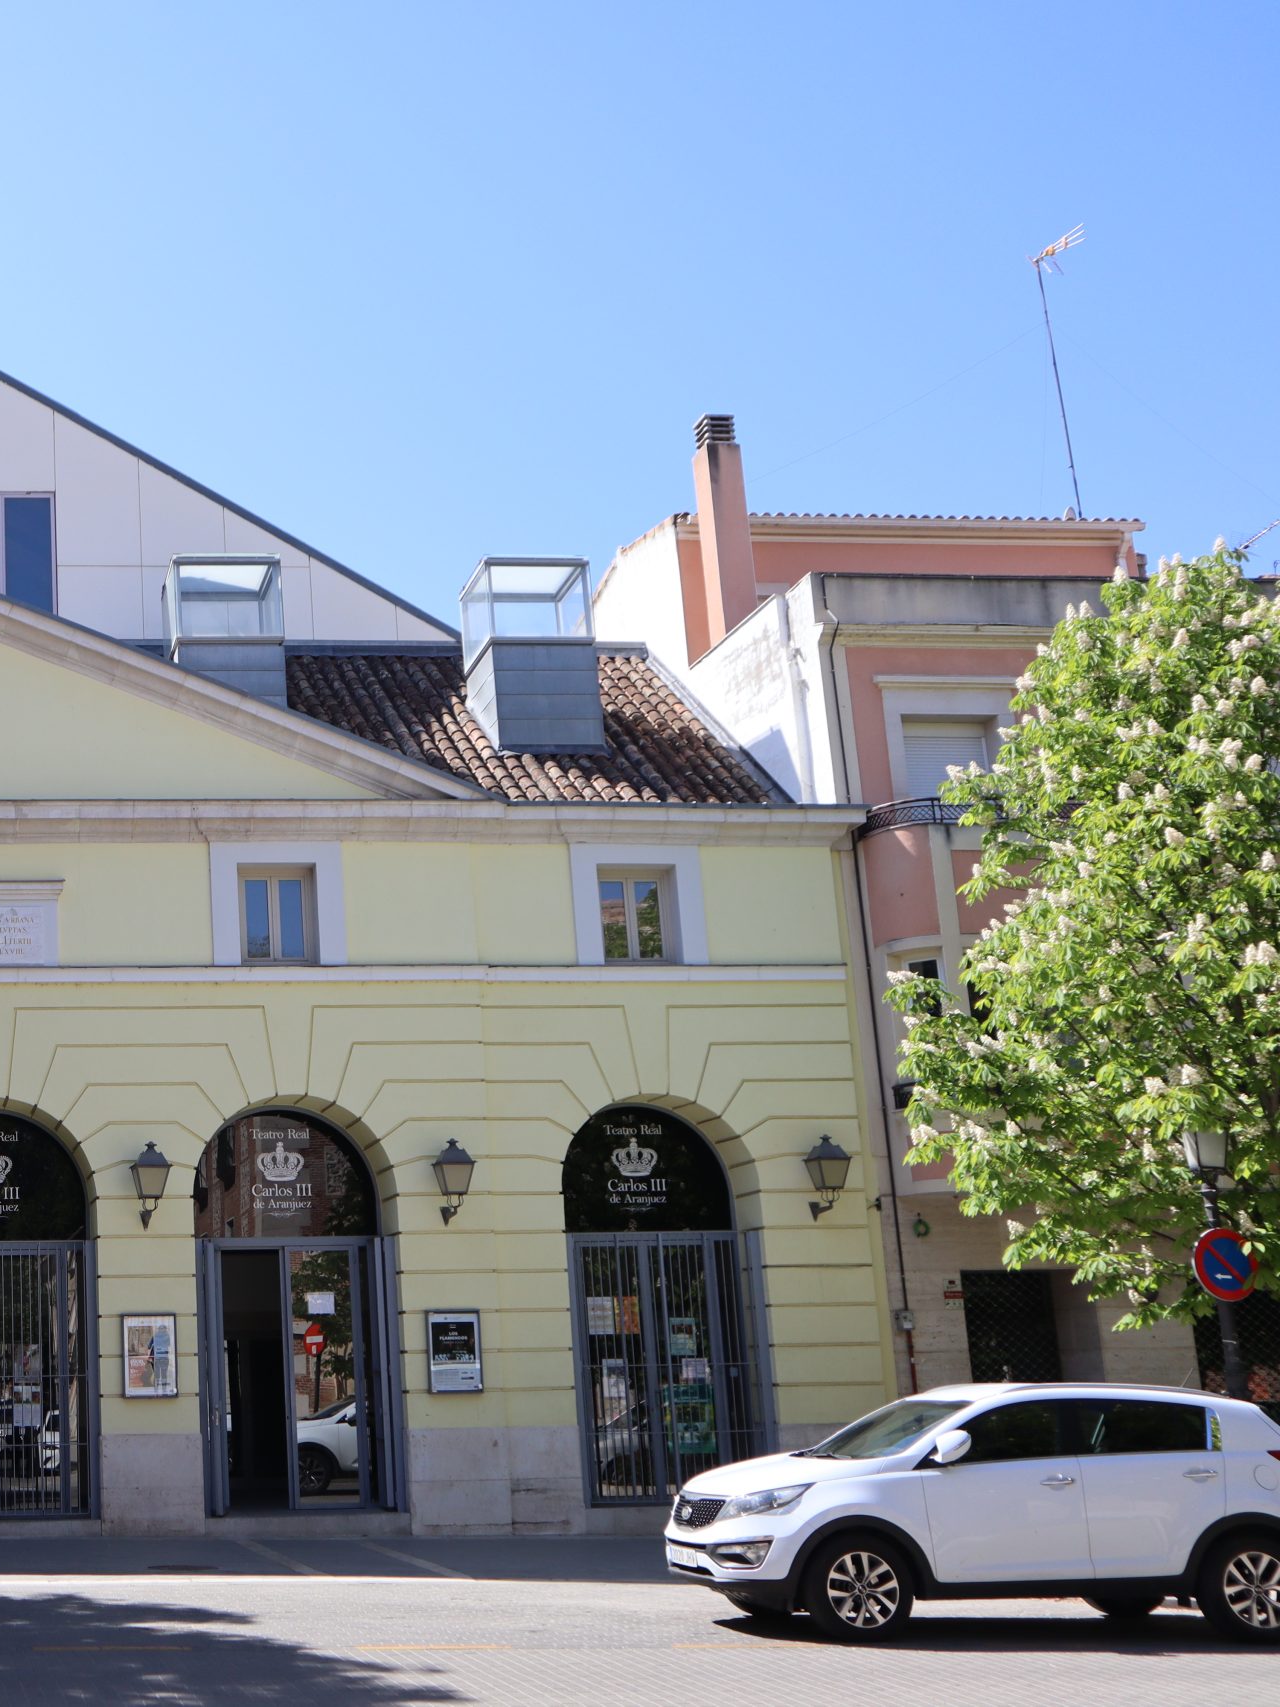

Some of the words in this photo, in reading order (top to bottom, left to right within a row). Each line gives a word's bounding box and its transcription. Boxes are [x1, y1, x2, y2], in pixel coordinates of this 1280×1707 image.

[250, 1129, 283, 1140] Teatro
[288, 1128, 309, 1139] Real
[603, 1125, 637, 1135] Teatro
[641, 1124, 662, 1134] Real
[252, 1184, 292, 1196] Carlos
[296, 1184, 312, 1196] III
[608, 1179, 647, 1191] Carlos
[651, 1179, 666, 1191] III
[4, 1187, 20, 1199] III
[253, 1199, 264, 1208] de
[268, 1198, 312, 1211] Aranjuez
[610, 1194, 621, 1203] de
[624, 1193, 666, 1206] Aranjuez
